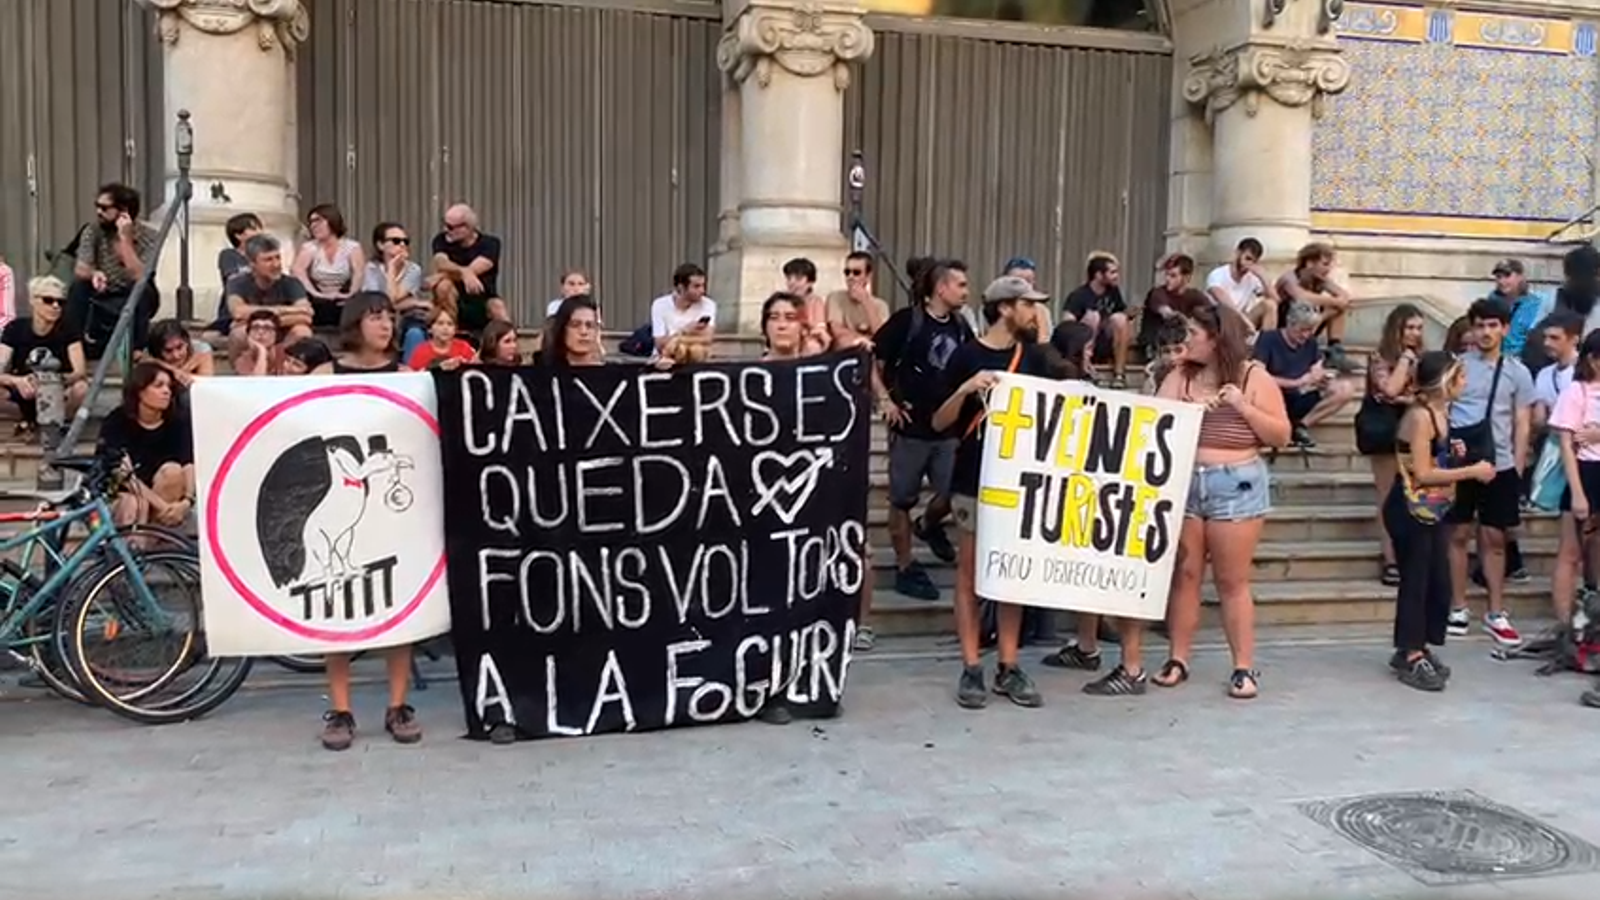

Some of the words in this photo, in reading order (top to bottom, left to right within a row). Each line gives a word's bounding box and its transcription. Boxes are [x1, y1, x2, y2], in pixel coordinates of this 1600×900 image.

[461, 366, 780, 456] CAIXERS
[795, 358, 860, 443] ES
[480, 453, 742, 538] QUEDA
[478, 546, 652, 634] FONS
[475, 651, 518, 727] A
[545, 649, 638, 736] LA
